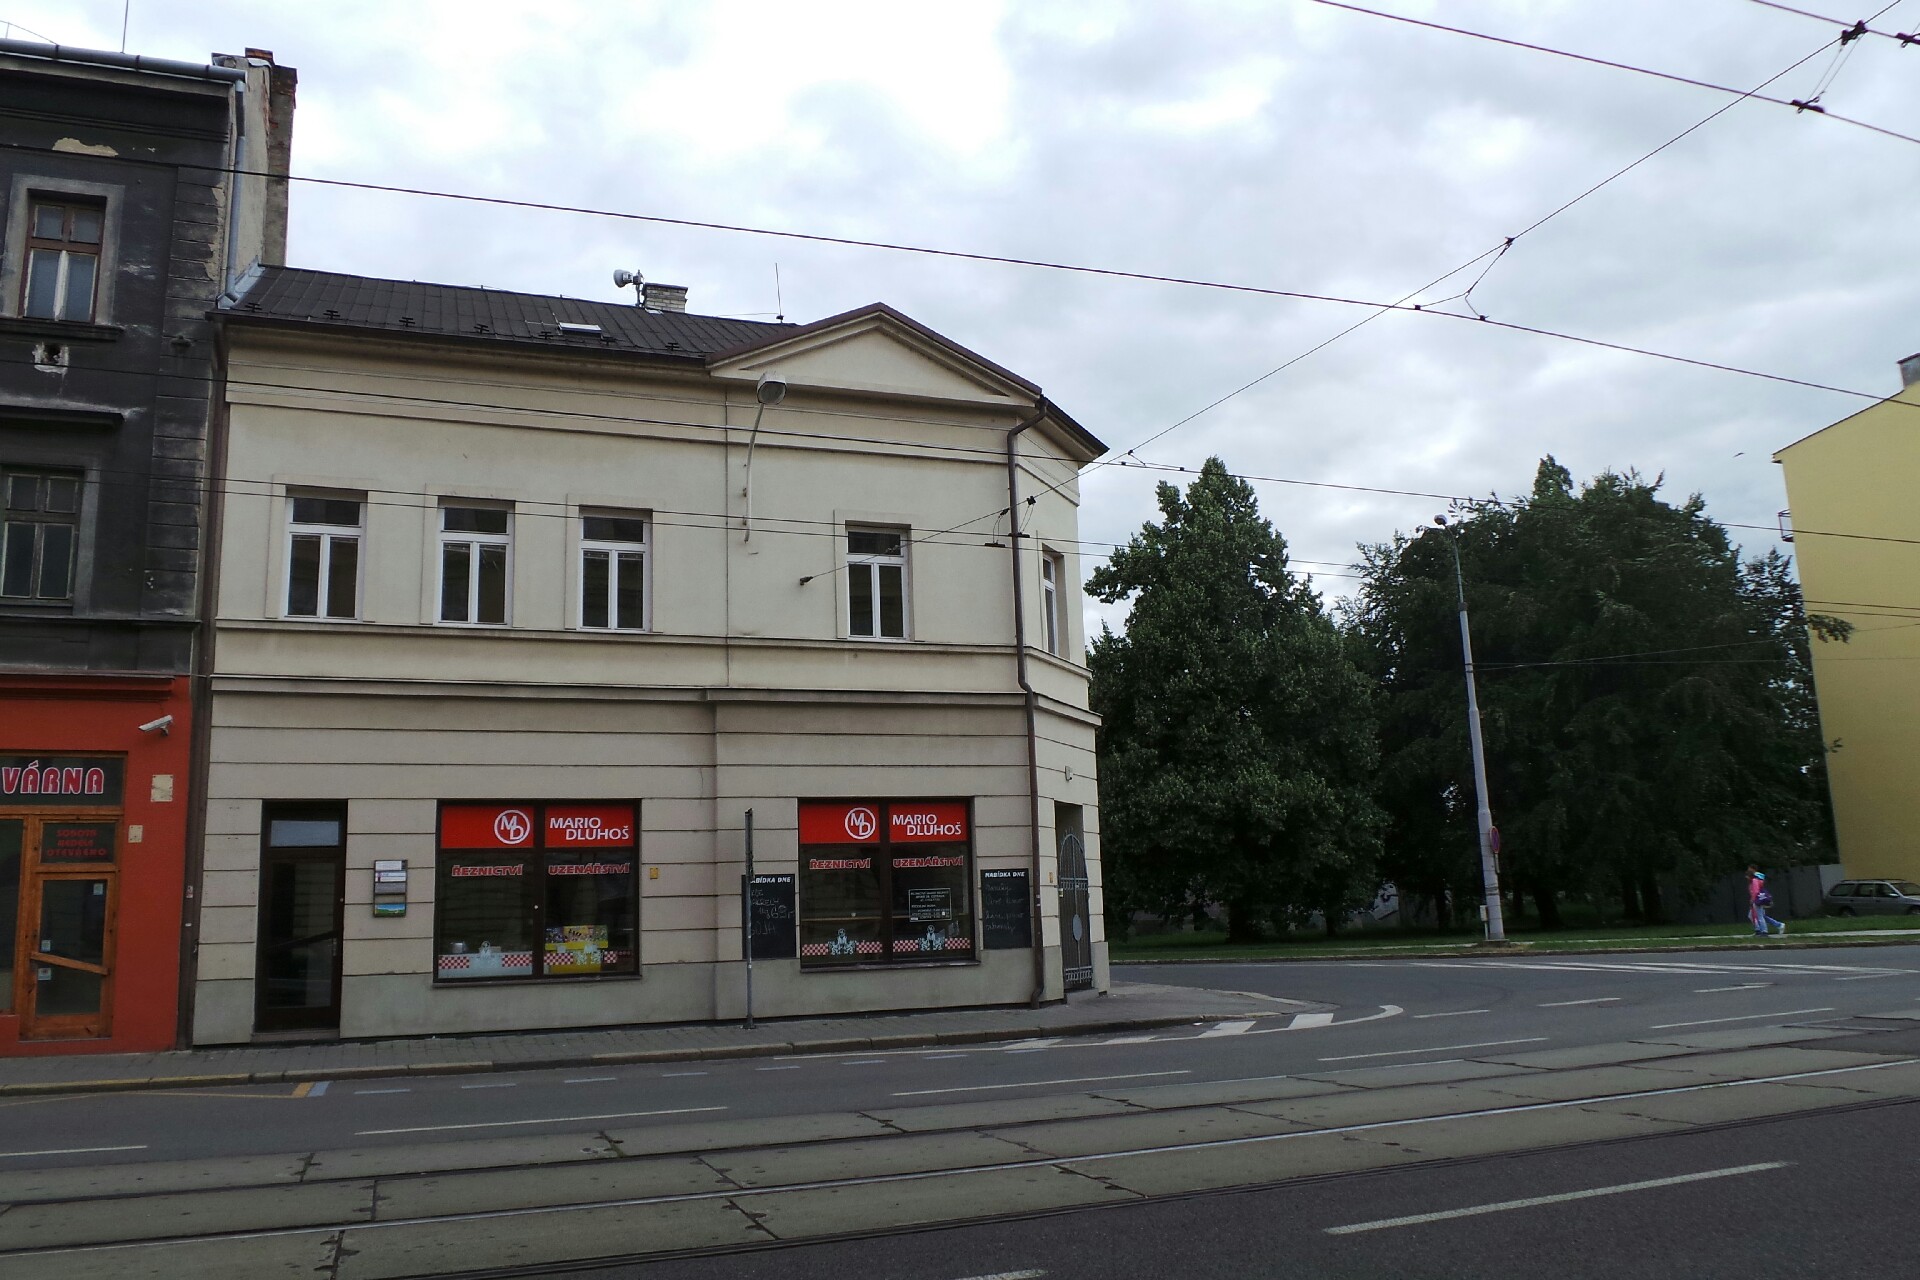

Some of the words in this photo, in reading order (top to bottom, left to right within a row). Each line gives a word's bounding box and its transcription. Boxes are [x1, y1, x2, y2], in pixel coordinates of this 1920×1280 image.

[1, 759, 105, 795] VÁRNA
[549, 817, 601, 829] MARIO
[892, 813, 937, 826] MARIO
[565, 825, 630, 841] DLUHOŠ
[906, 821, 962, 836] DLUHOŠ
[809, 857, 871, 870] ŘEZNICTVÍ
[892, 855, 964, 868] UZENÁŘSTVÍ
[451, 864, 524, 877] ŘEZNICTVÍ
[548, 862, 630, 875] UZENÁŘSTVÍ
[984, 870, 1011, 878] NABÍDKA
